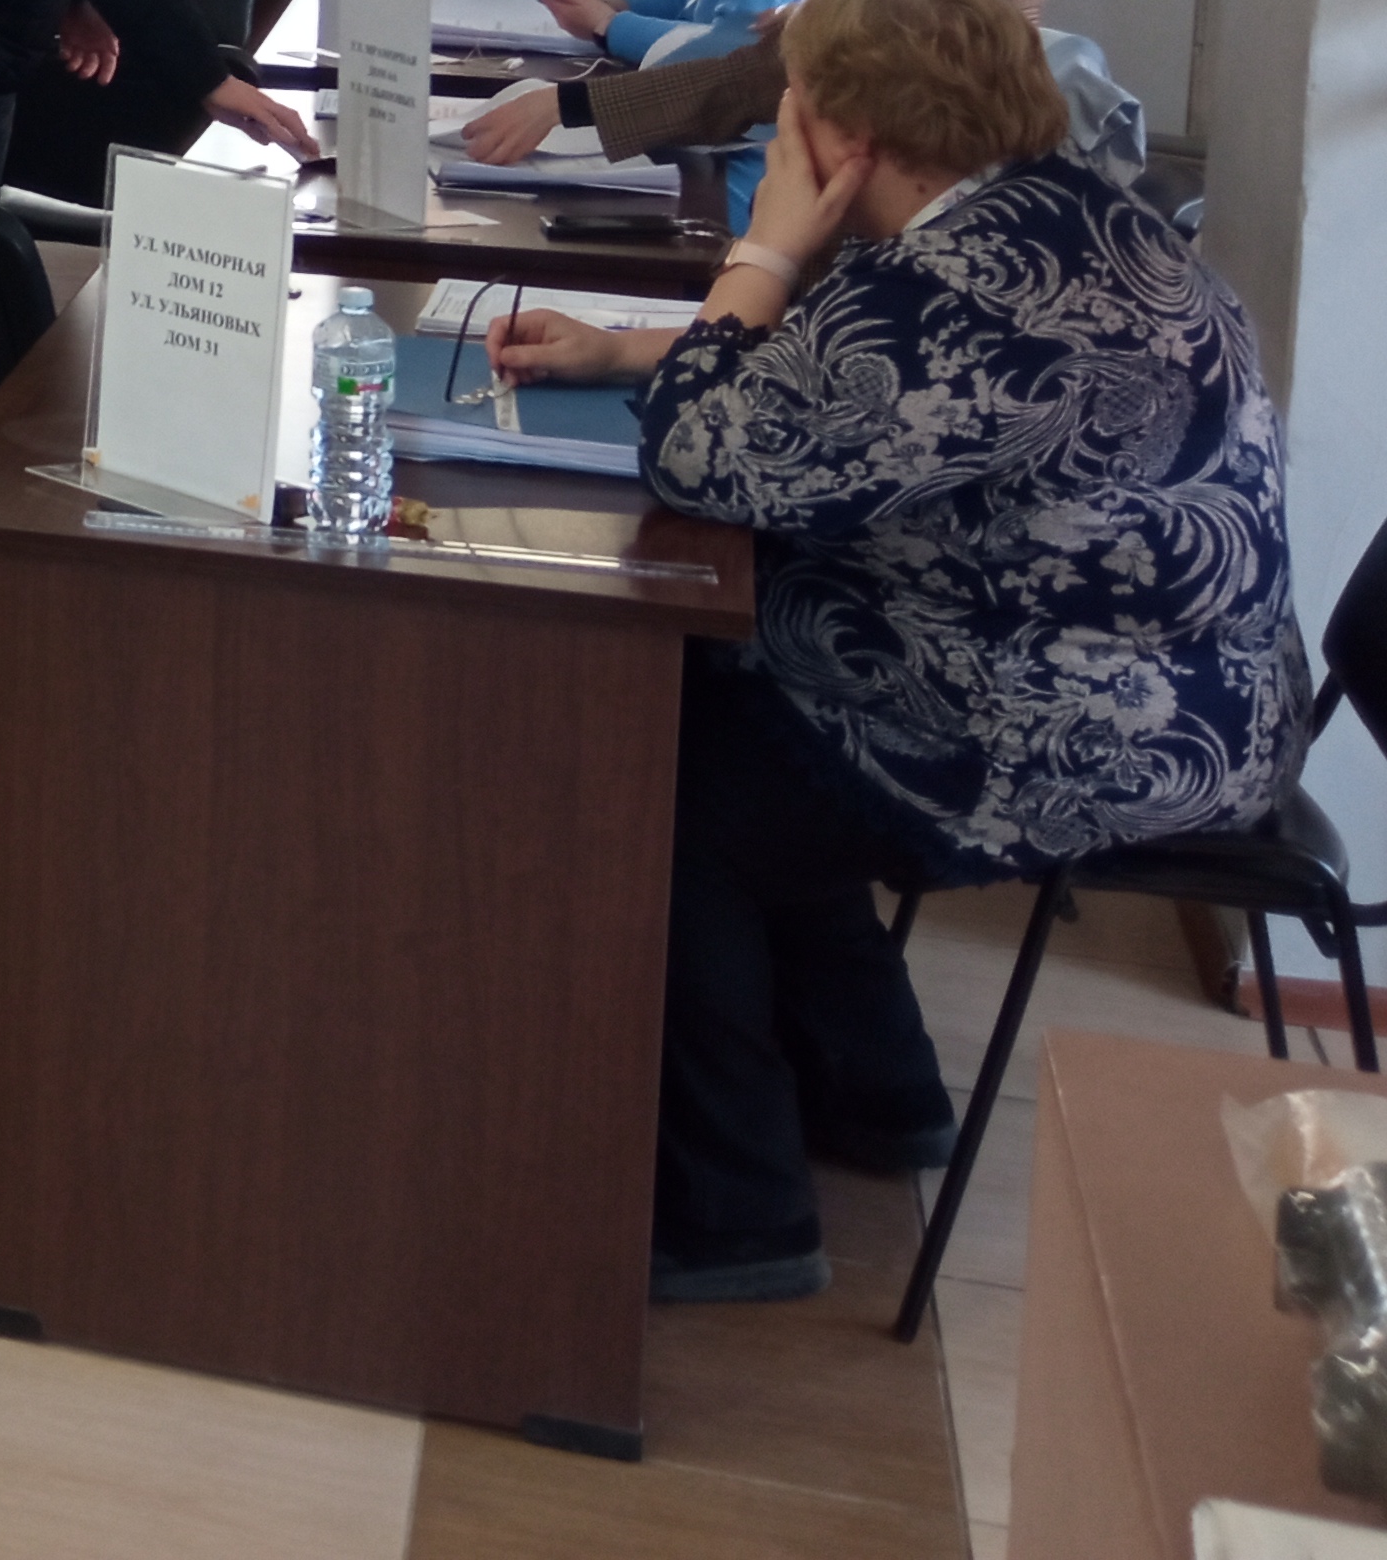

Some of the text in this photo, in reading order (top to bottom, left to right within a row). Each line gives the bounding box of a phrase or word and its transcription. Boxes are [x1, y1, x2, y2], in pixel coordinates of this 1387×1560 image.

[133, 233, 266, 278] УЛ. МРАМОРНАЯ
[167, 271, 224, 298] ДОМ 12
[131, 290, 262, 338] УЛ. УЛЬЯНОВЫХ
[163, 329, 219, 357] ДОМ 31
